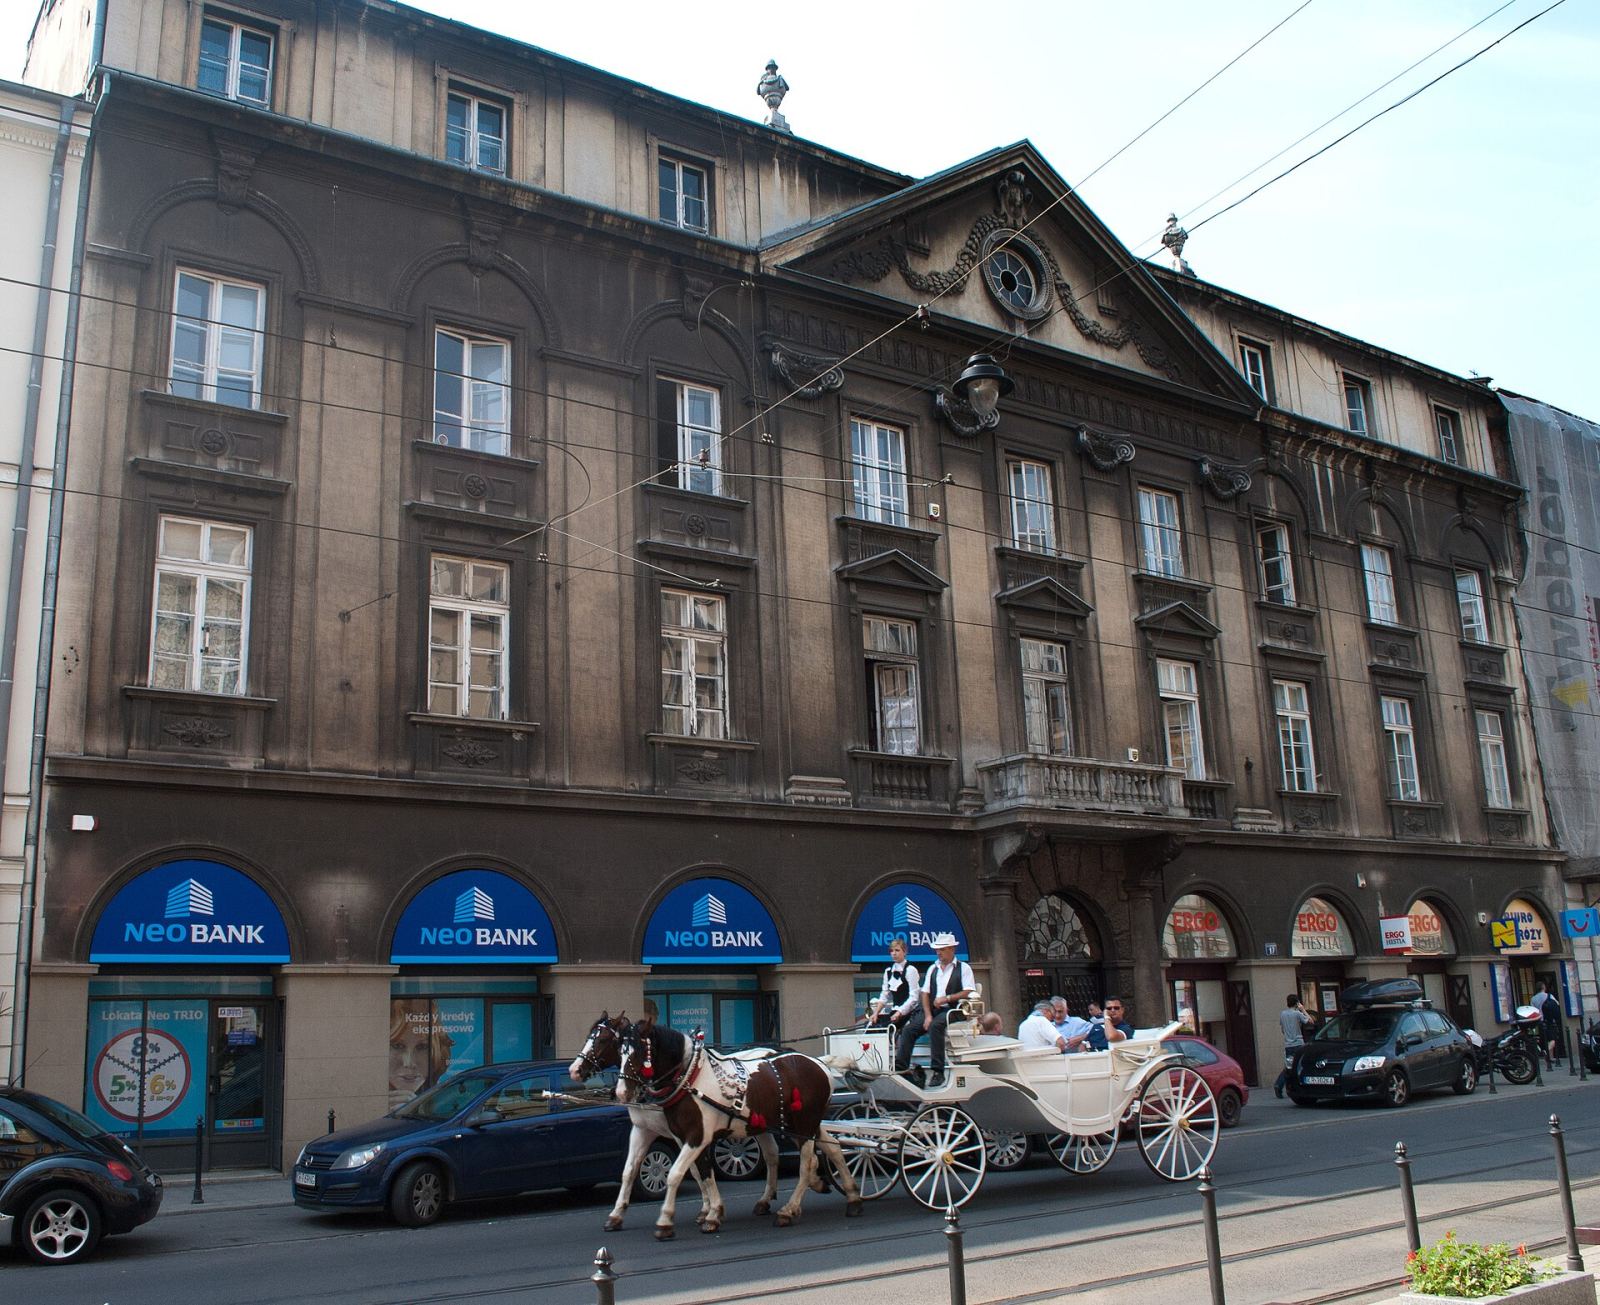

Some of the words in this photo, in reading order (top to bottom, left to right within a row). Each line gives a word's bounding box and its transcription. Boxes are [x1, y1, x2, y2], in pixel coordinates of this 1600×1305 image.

[1173, 911, 1218, 933] ERGO
[1297, 912, 1337, 932] ERGO
[1408, 914, 1441, 931] ERGO
[1384, 930, 1405, 939] ERGO
[1300, 935, 1340, 950] HESTIA
[102, 1010, 142, 1020] Lokata
[147, 1010, 170, 1020] Neo
[173, 1010, 203, 1020] TRIO
[441, 1010, 475, 1023] kredyt
